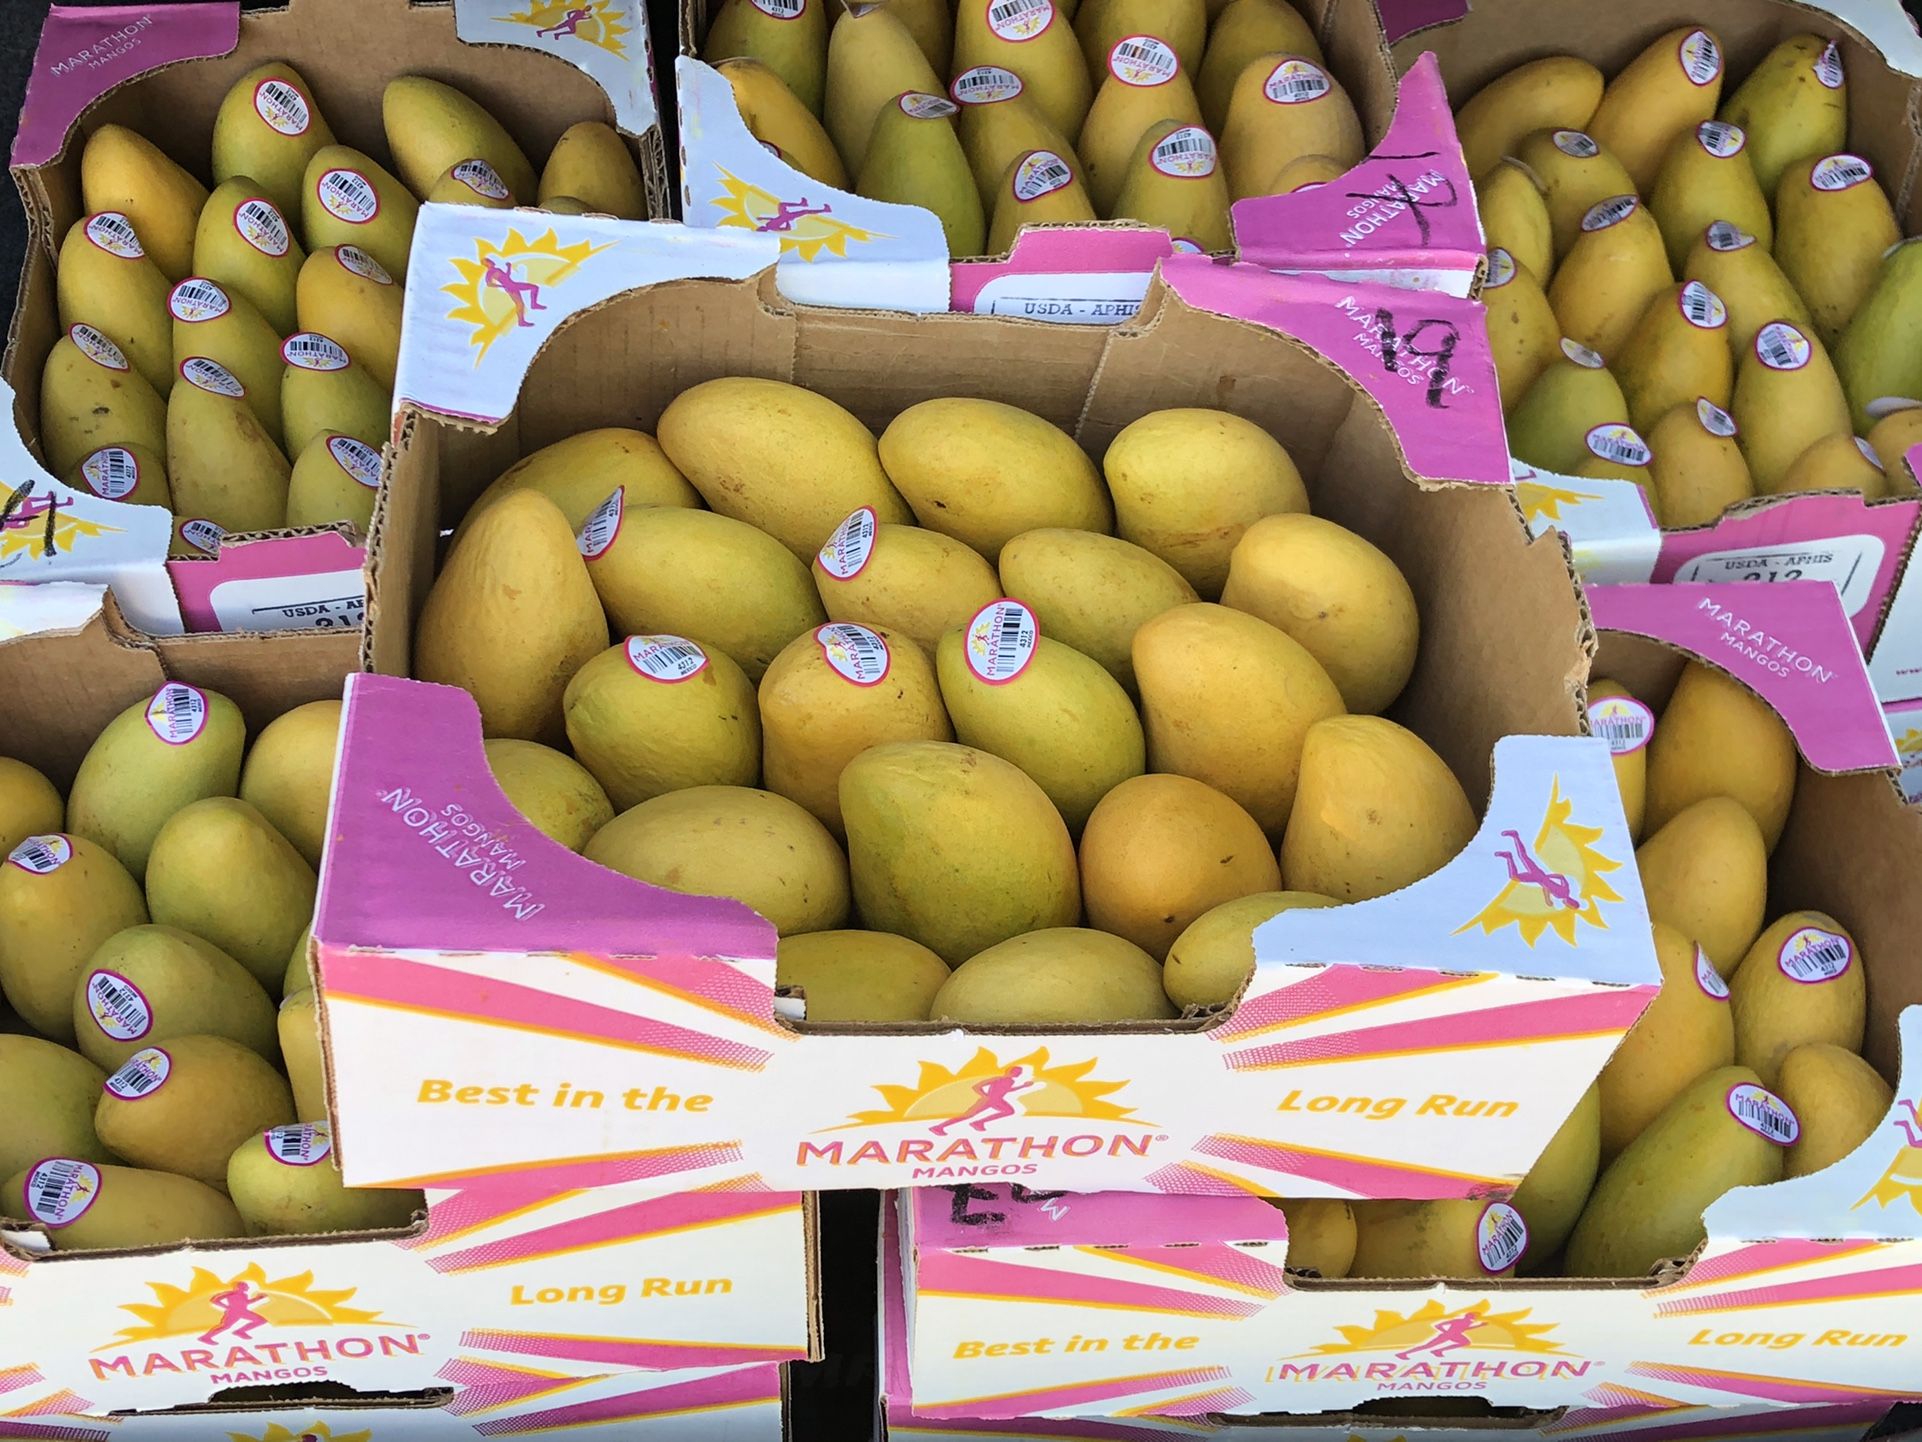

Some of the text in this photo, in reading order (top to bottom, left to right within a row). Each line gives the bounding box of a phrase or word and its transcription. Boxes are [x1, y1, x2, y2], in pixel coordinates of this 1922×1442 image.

[50, 14, 153, 77] MARATHON
[88, 38, 141, 69] MANGOS
[322, 182, 369, 218] MARATHON
[1024, 303, 1073, 315] USDA
[1725, 560, 1768, 570] USDA
[282, 604, 330, 617] USDA
[987, 607, 1005, 676] MARATHON
[1019, 630, 1029, 648] 4312
[1699, 598, 1836, 683] MARATHON
[678, 656, 696, 671] 4312
[1721, 632, 1790, 677] MANGOS
[440, 803, 526, 870] MANGOS
[379, 787, 545, 920] MARATHON
[92, 982, 138, 1035] MARATHON
[417, 1079, 714, 1112] Best in the
[1276, 1089, 1519, 1120] Long Run
[39, 1172, 50, 1191] 4312
[912, 1164, 1037, 1180] MANGOS
[510, 1277, 733, 1306] Long Run
[953, 1332, 1200, 1360] Best in the
[1687, 1329, 1908, 1349] Long Run
[210, 1366, 328, 1385] MANGOS
[1377, 1381, 1488, 1391] MANGOS
